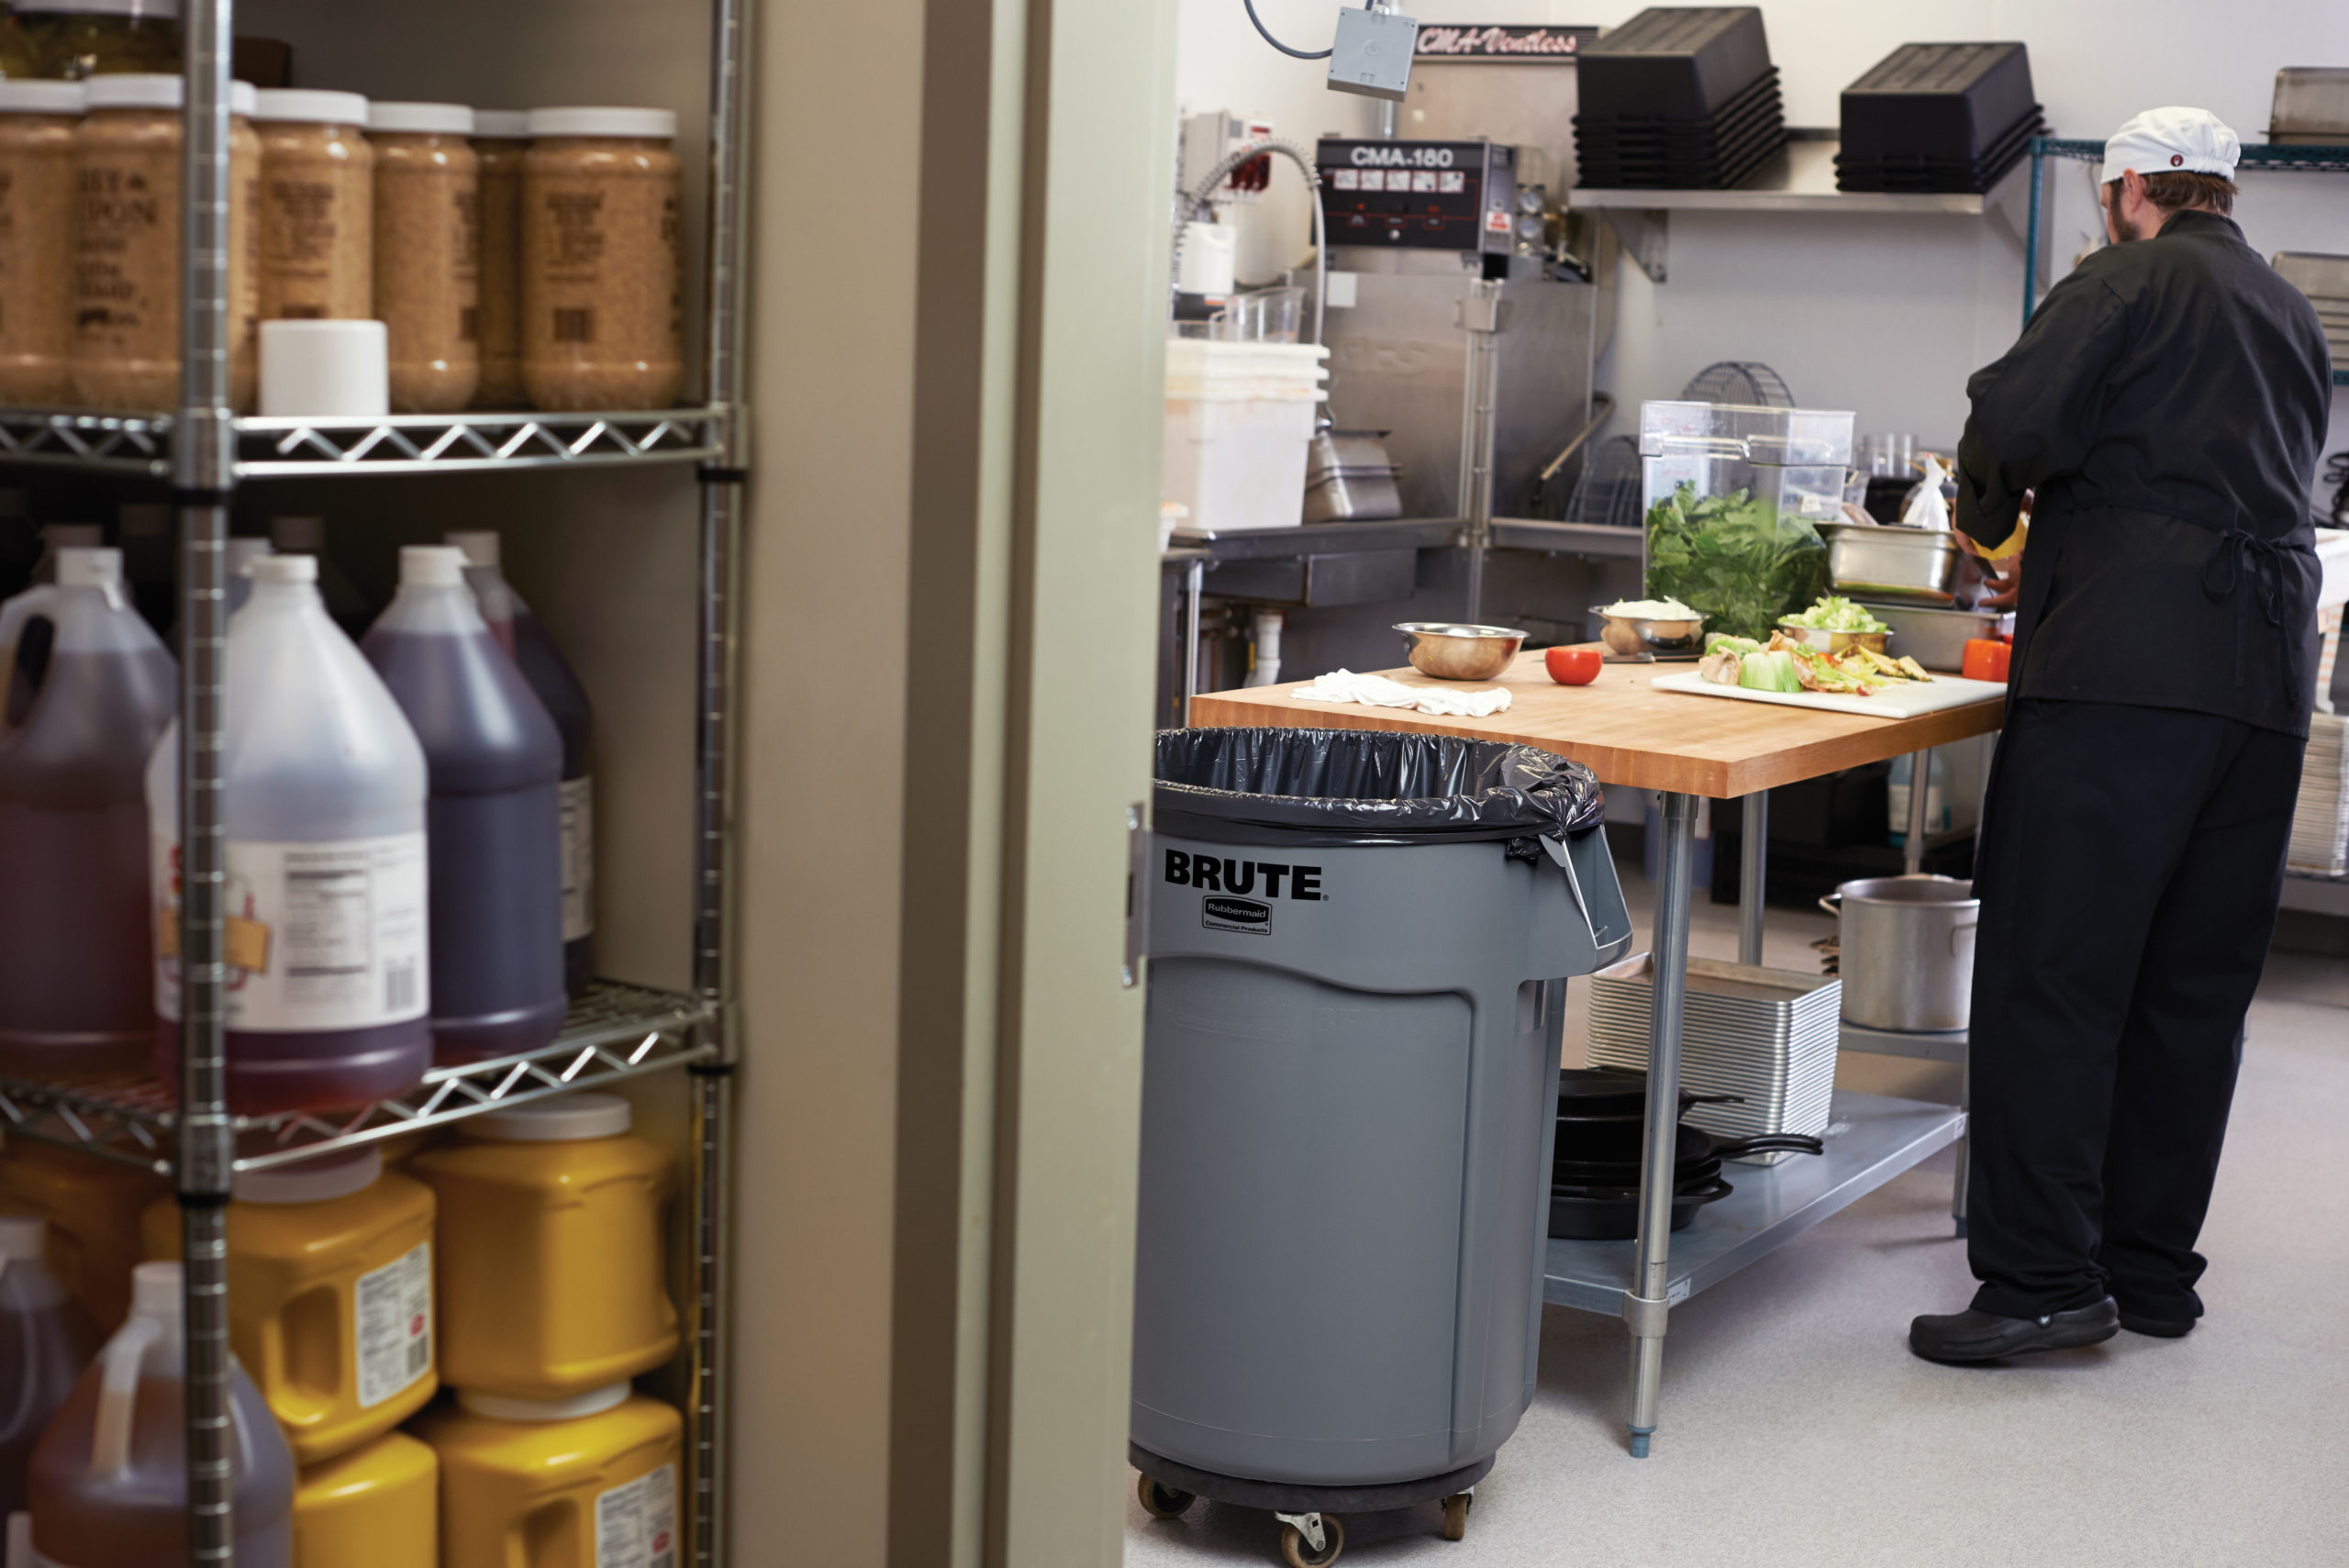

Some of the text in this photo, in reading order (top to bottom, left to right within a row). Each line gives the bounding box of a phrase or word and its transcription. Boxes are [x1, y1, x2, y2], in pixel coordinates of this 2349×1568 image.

[1351, 146, 1453, 168] CMA-180
[1208, 903, 1266, 918] Rubbermaid
[1205, 920, 1268, 933] Commercial Products
